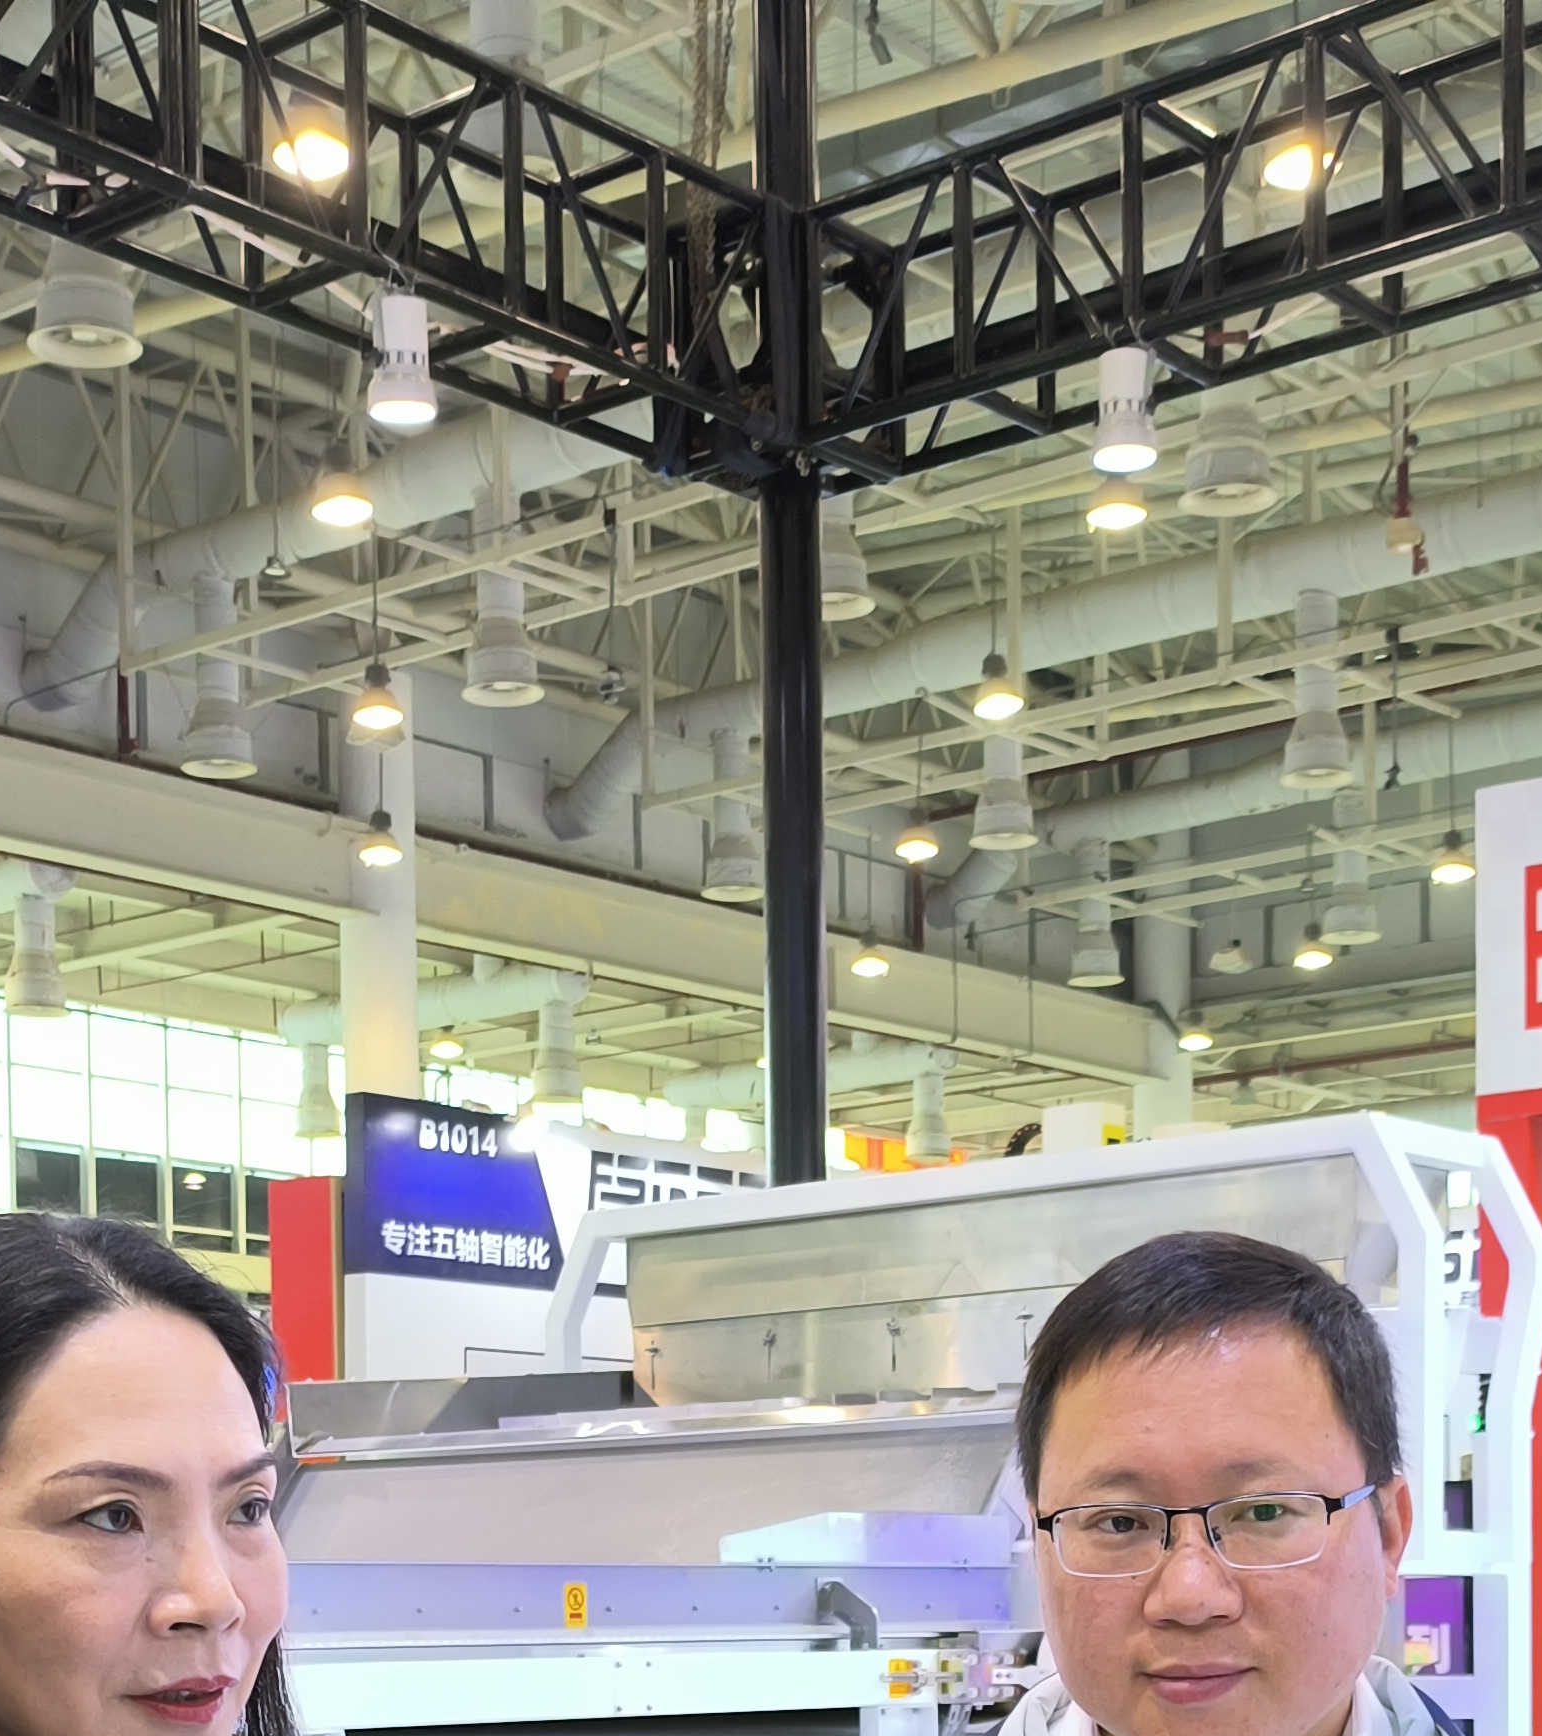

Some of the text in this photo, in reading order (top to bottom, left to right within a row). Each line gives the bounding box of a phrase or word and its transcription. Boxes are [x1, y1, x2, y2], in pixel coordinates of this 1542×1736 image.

[418, 1118, 498, 1158] B1014
[381, 1220, 551, 1271] 专注五轴智能化
